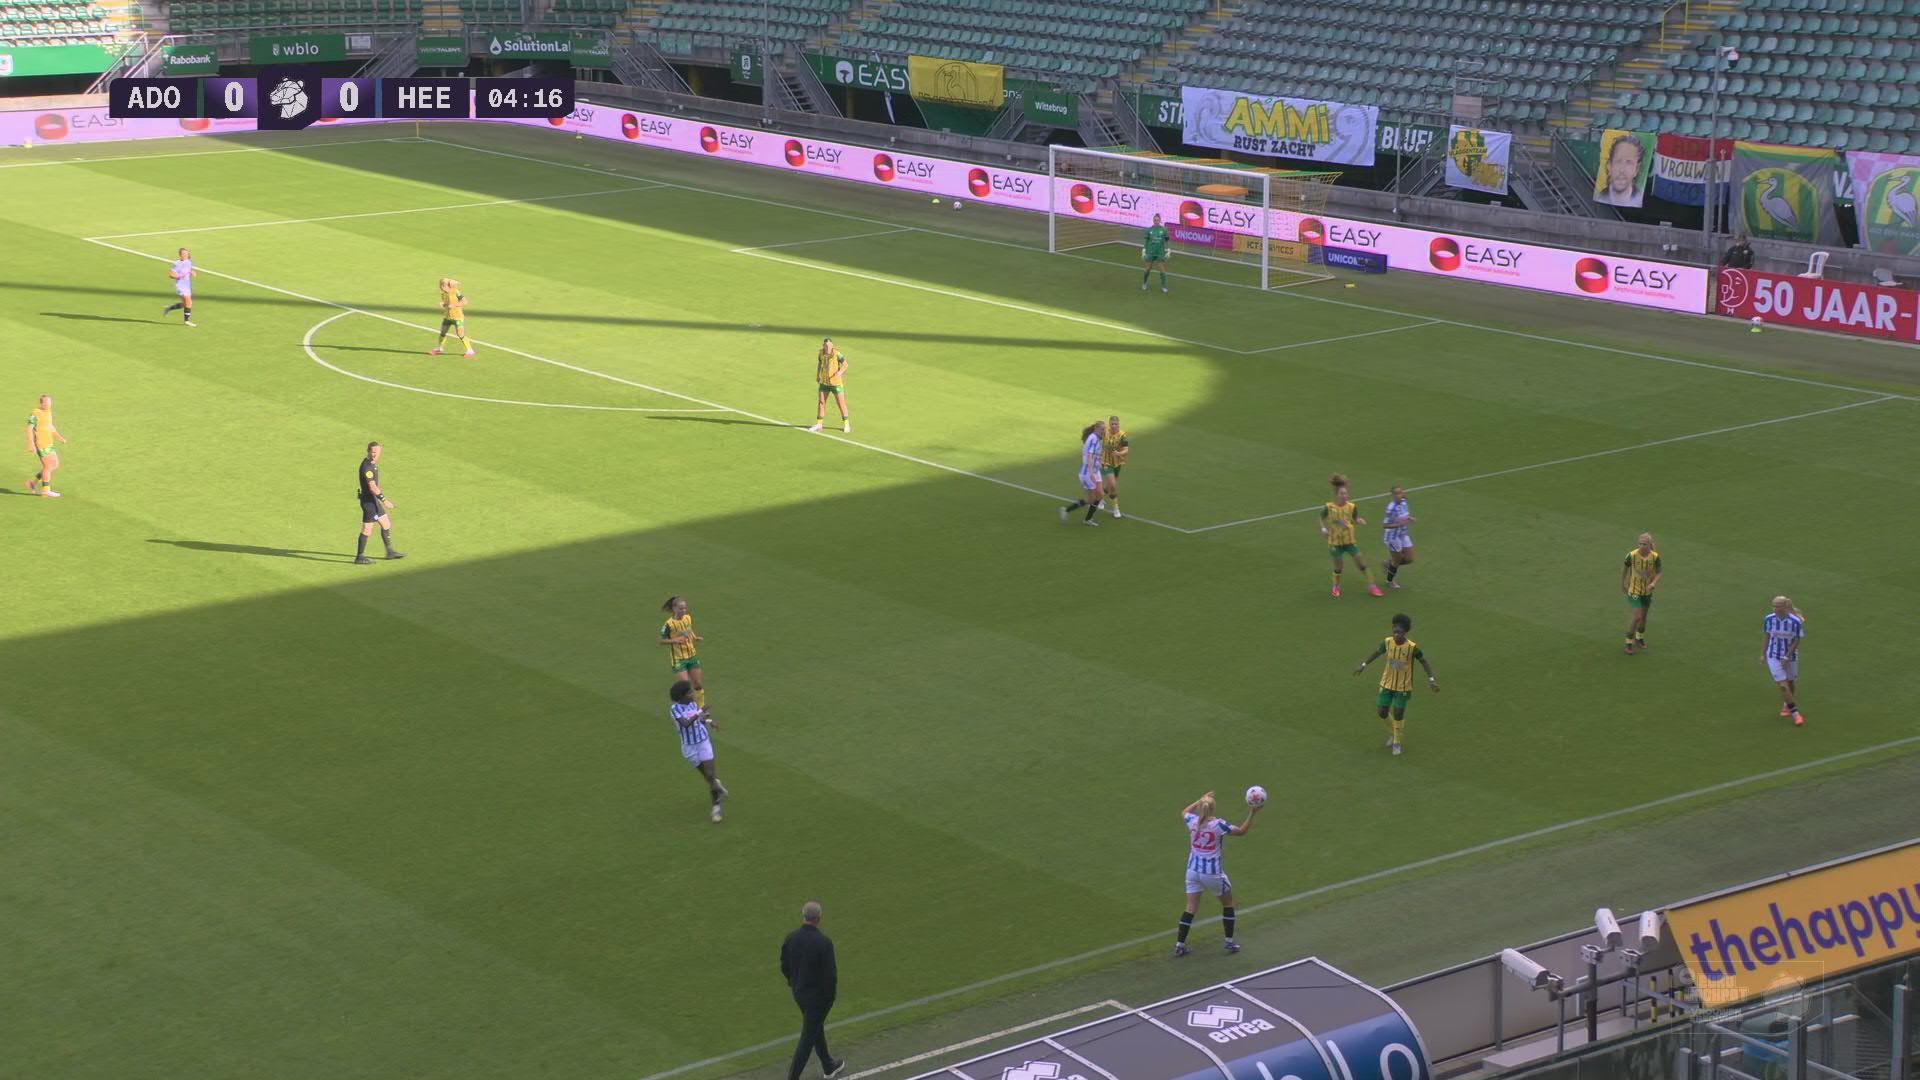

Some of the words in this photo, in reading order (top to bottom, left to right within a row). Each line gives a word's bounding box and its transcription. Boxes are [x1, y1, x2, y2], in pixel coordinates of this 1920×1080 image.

[170, 54, 211, 65] Rabobank
[283, 43, 319, 56] wblo
[1034, 101, 1068, 116] Wittebrug
[640, 118, 672, 136] EASY
[720, 131, 754, 150] EASY
[1233, 135, 1268, 153] RUST
[1271, 140, 1316, 158] ZACHT
[806, 144, 842, 164] EASY
[897, 159, 934, 179] EASY
[993, 174, 1033, 194] EASY
[1097, 189, 1141, 211] EASY
[1208, 207, 1256, 229] EASY
[1329, 225, 1382, 248] EASY
[1465, 244, 1523, 269] EASY
[1614, 265, 1678, 291] EASY
[1753, 278, 1794, 317] 50
[1802, 286, 1913, 332] JAAR-
[1192, 831, 1217, 852] 22
[1208, 1017, 1277, 1044] errea
